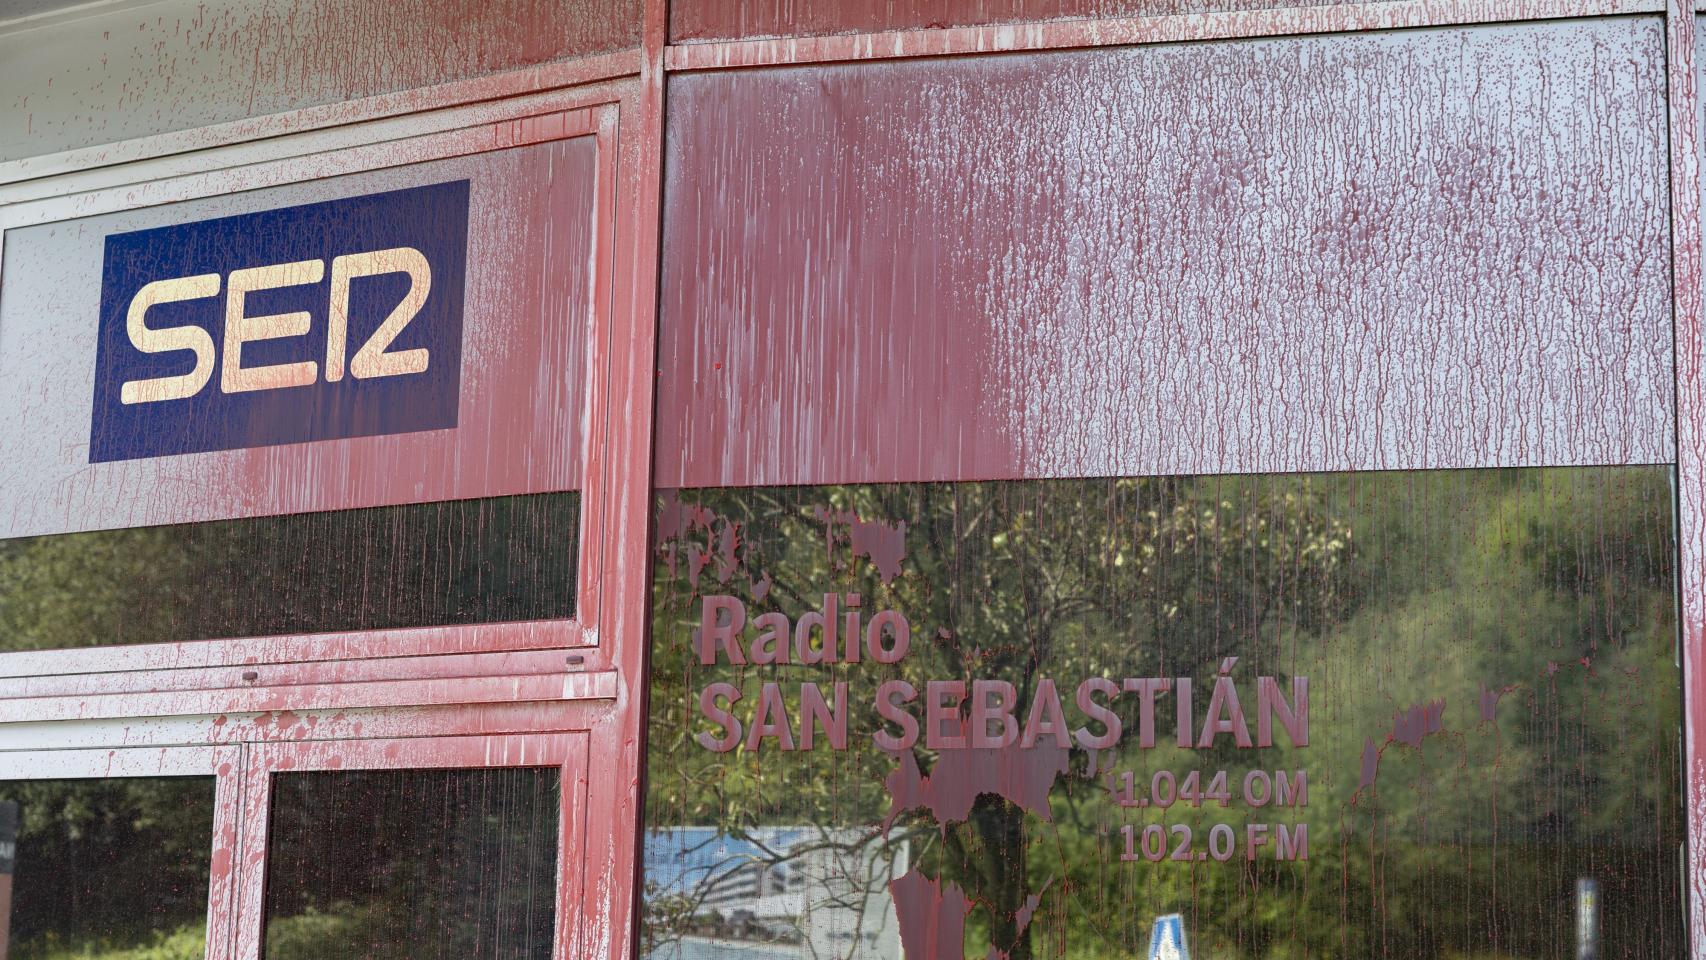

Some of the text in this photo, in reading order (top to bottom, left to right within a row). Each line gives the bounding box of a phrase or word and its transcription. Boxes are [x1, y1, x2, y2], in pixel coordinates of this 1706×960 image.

[121, 247, 431, 405] SER
[701, 592, 910, 665] Radio
[699, 657, 1310, 751] SAN SEBASTIÁN
[1120, 769, 1308, 808] 1.044 OM
[1120, 823, 1308, 861] 102.0 FM
